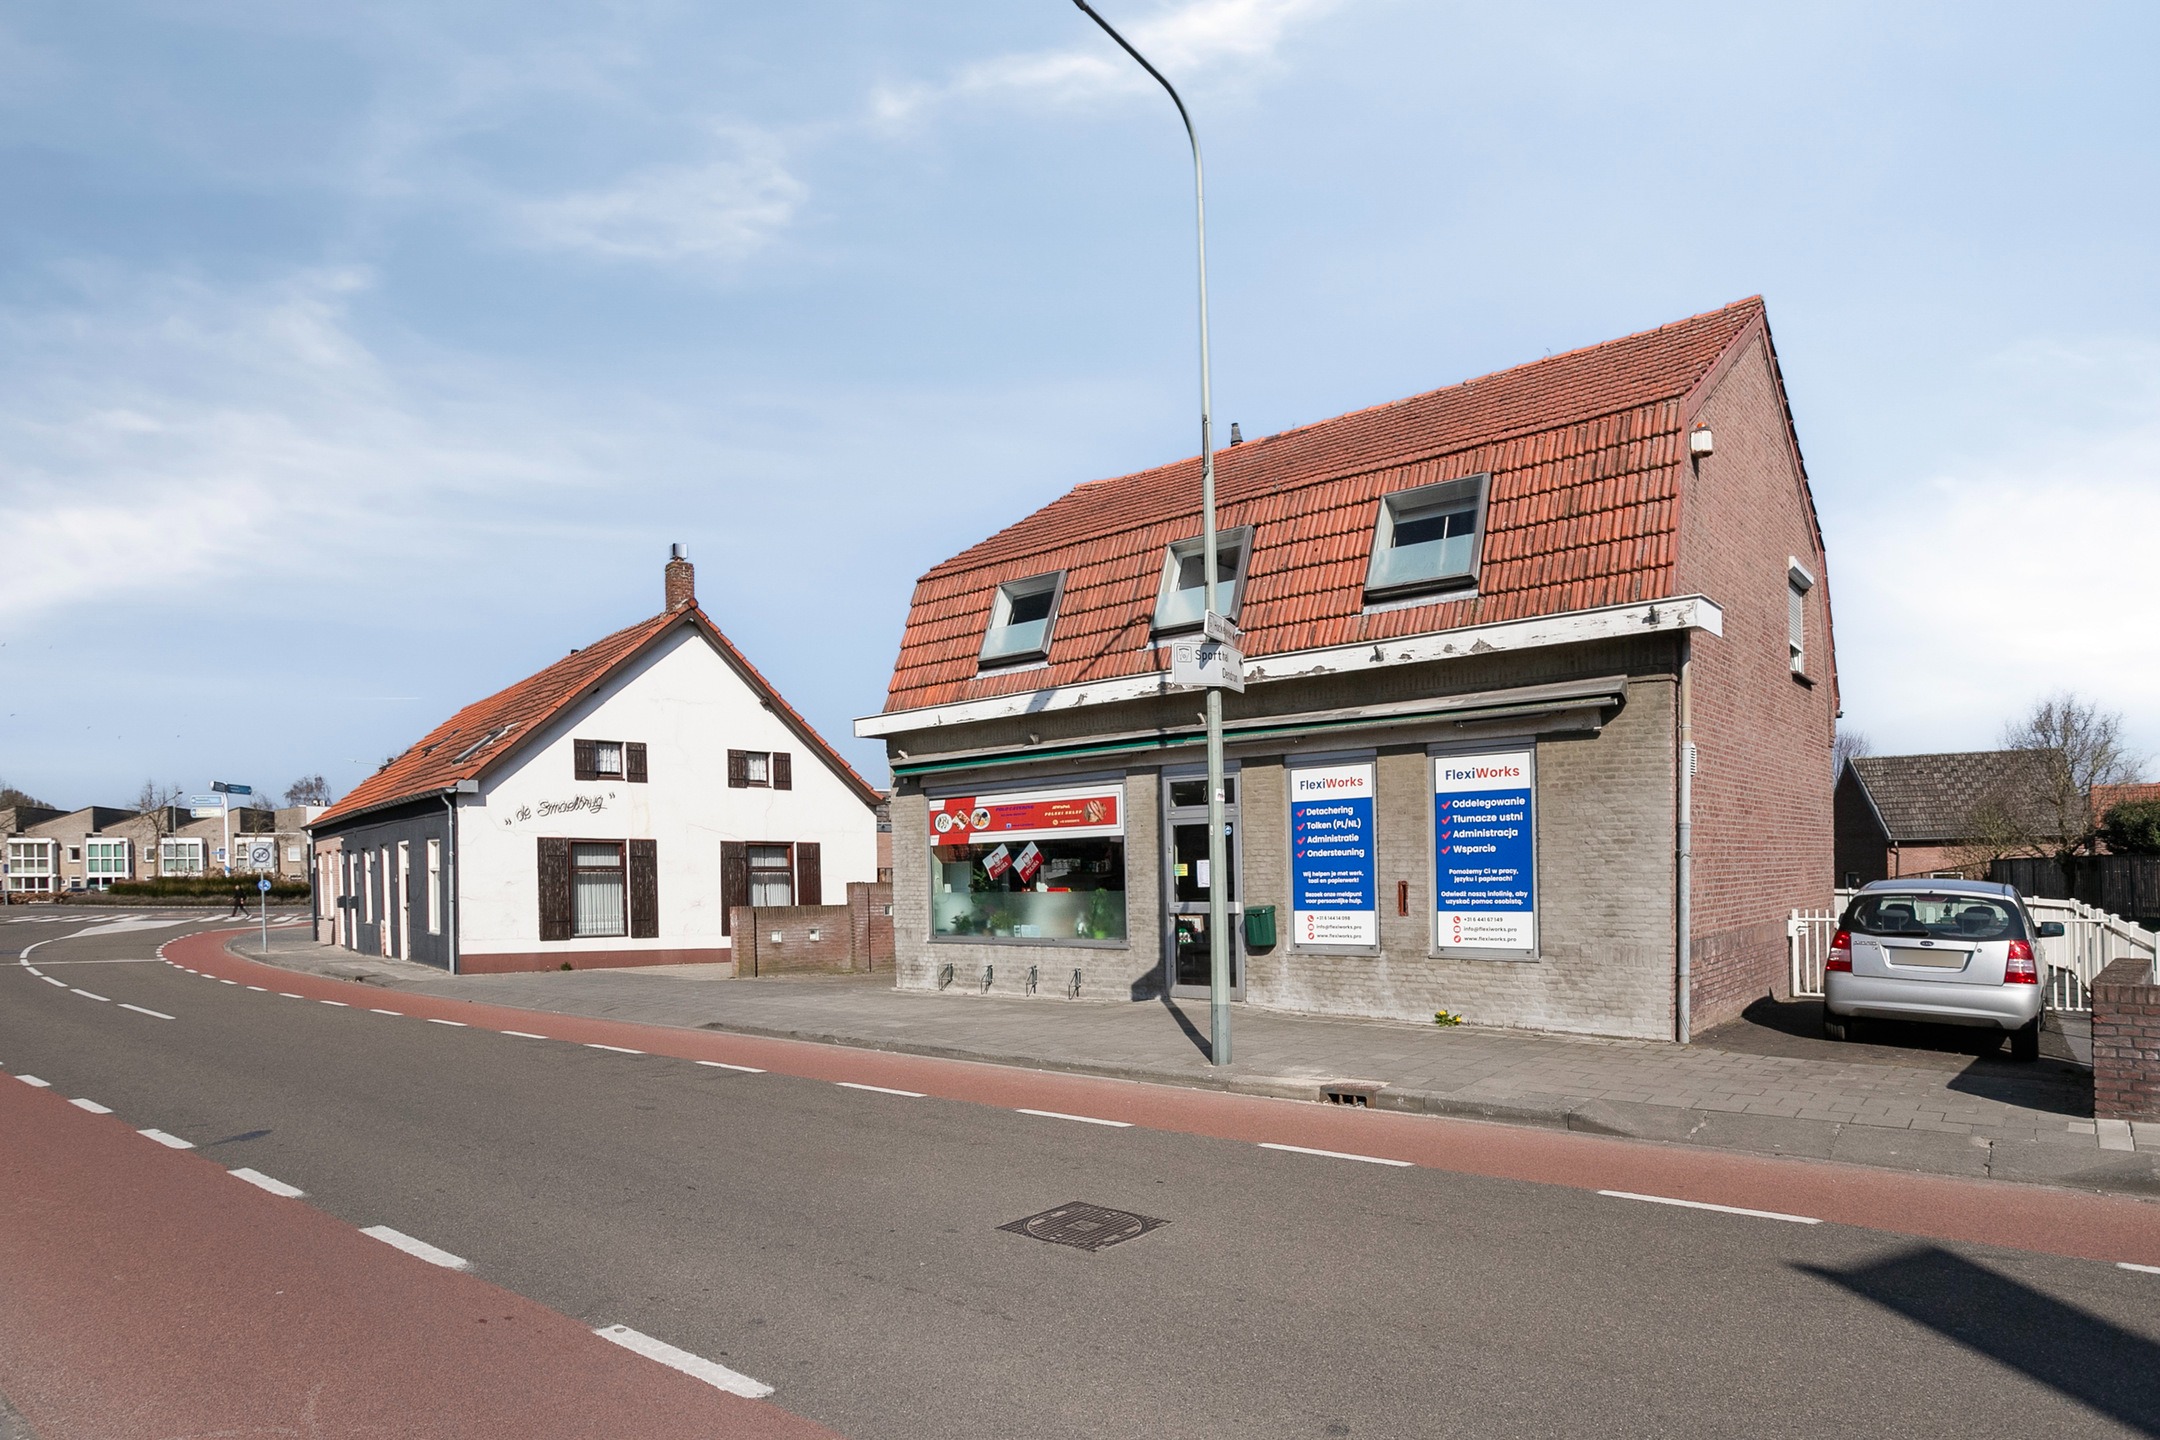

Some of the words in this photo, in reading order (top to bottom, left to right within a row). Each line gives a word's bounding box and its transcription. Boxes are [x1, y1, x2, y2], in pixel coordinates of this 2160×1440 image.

[1445, 766, 1520, 780] FlexiWorks
[1300, 777, 1363, 790] FlexiWorks
[1452, 796, 1526, 809] Oddelegowanie
[1306, 806, 1354, 816] Detachering
[1452, 814, 1497, 823] Tłumacze
[1499, 811, 1523, 821] ustni
[1306, 821, 1332, 830] Tolken
[1333, 818, 1361, 830] (PL/NL)
[1307, 834, 1360, 844] Administratie
[1453, 828, 1519, 839] Administracja
[1307, 848, 1365, 858] Ondersteuning
[1453, 843, 1497, 855] Wsparcie
[1327, 877, 1359, 885] papierwerk!
[1478, 875, 1513, 883] papierach!
[1515, 890, 1528, 898] aby
